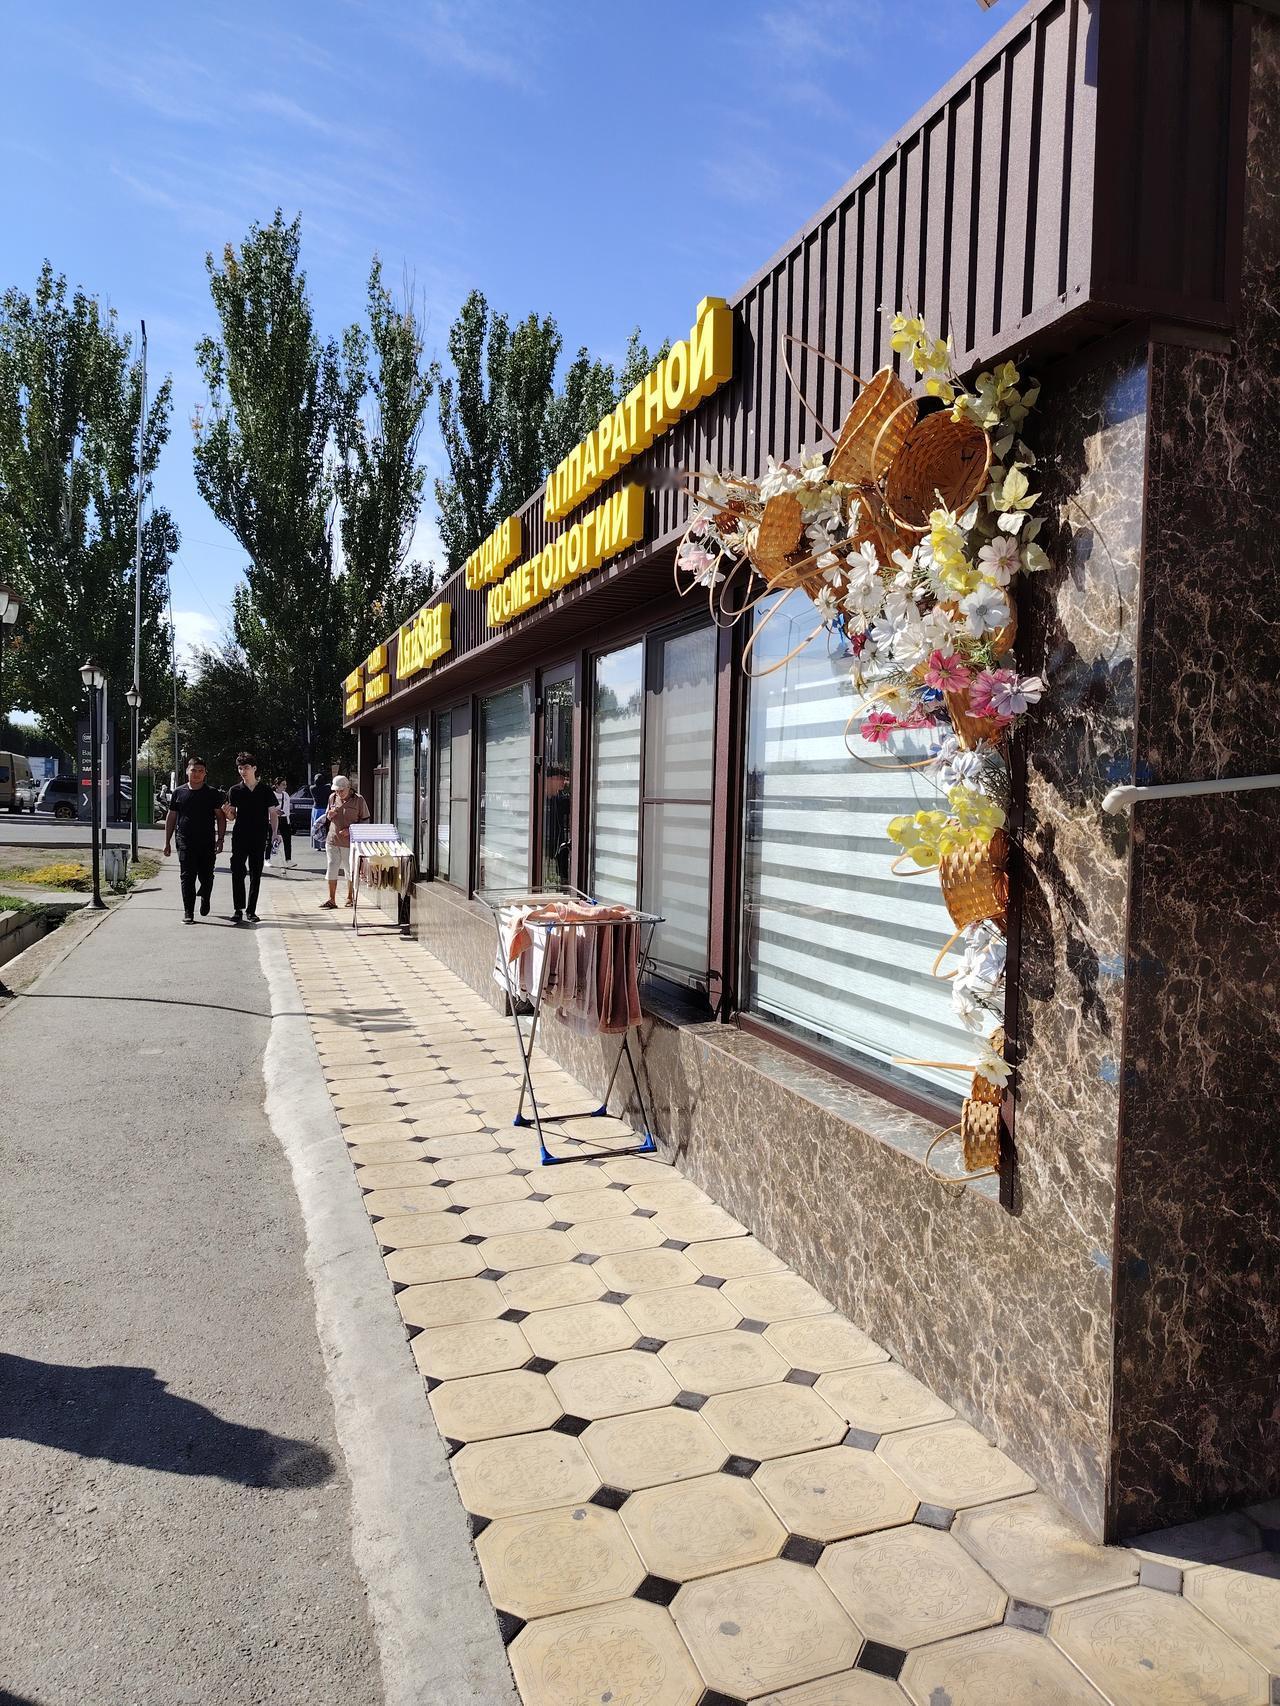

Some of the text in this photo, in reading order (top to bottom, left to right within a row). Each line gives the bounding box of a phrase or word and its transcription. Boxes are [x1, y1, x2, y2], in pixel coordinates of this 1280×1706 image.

[465, 296, 720, 590] СТУДИЯ АППАРАТНОЙ
[487, 484, 633, 627] КОСМЕТОЛОГИИ
